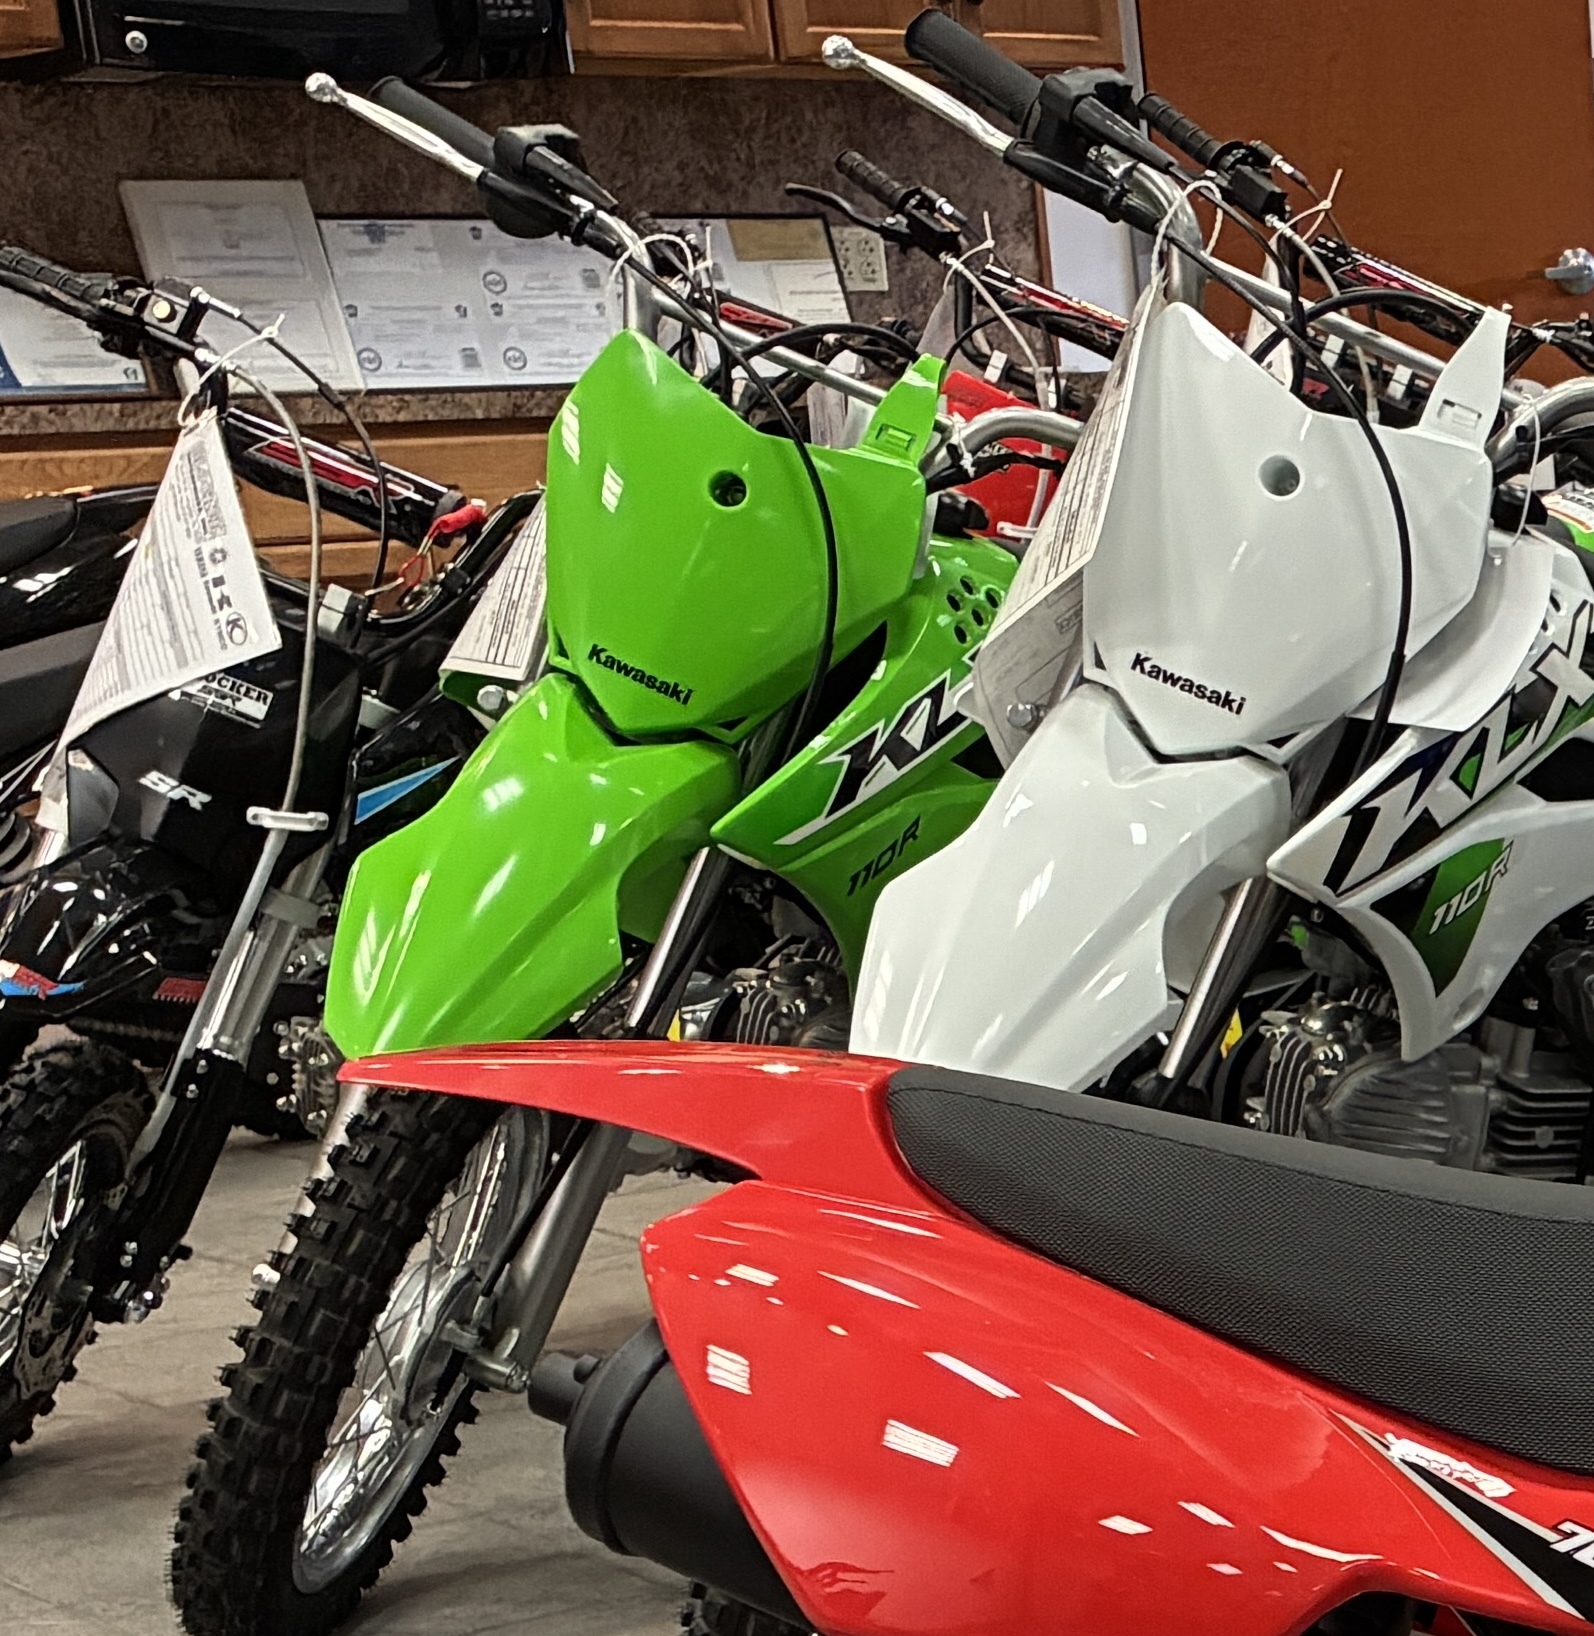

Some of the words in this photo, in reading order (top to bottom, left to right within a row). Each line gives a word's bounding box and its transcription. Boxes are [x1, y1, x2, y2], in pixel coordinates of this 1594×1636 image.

[204, 673, 271, 706] OCKER
[588, 643, 694, 705] Kawasaki
[1130, 652, 1247, 717] Kawasaki
[847, 814, 921, 896] 110R
[1430, 840, 1514, 936] 110R
